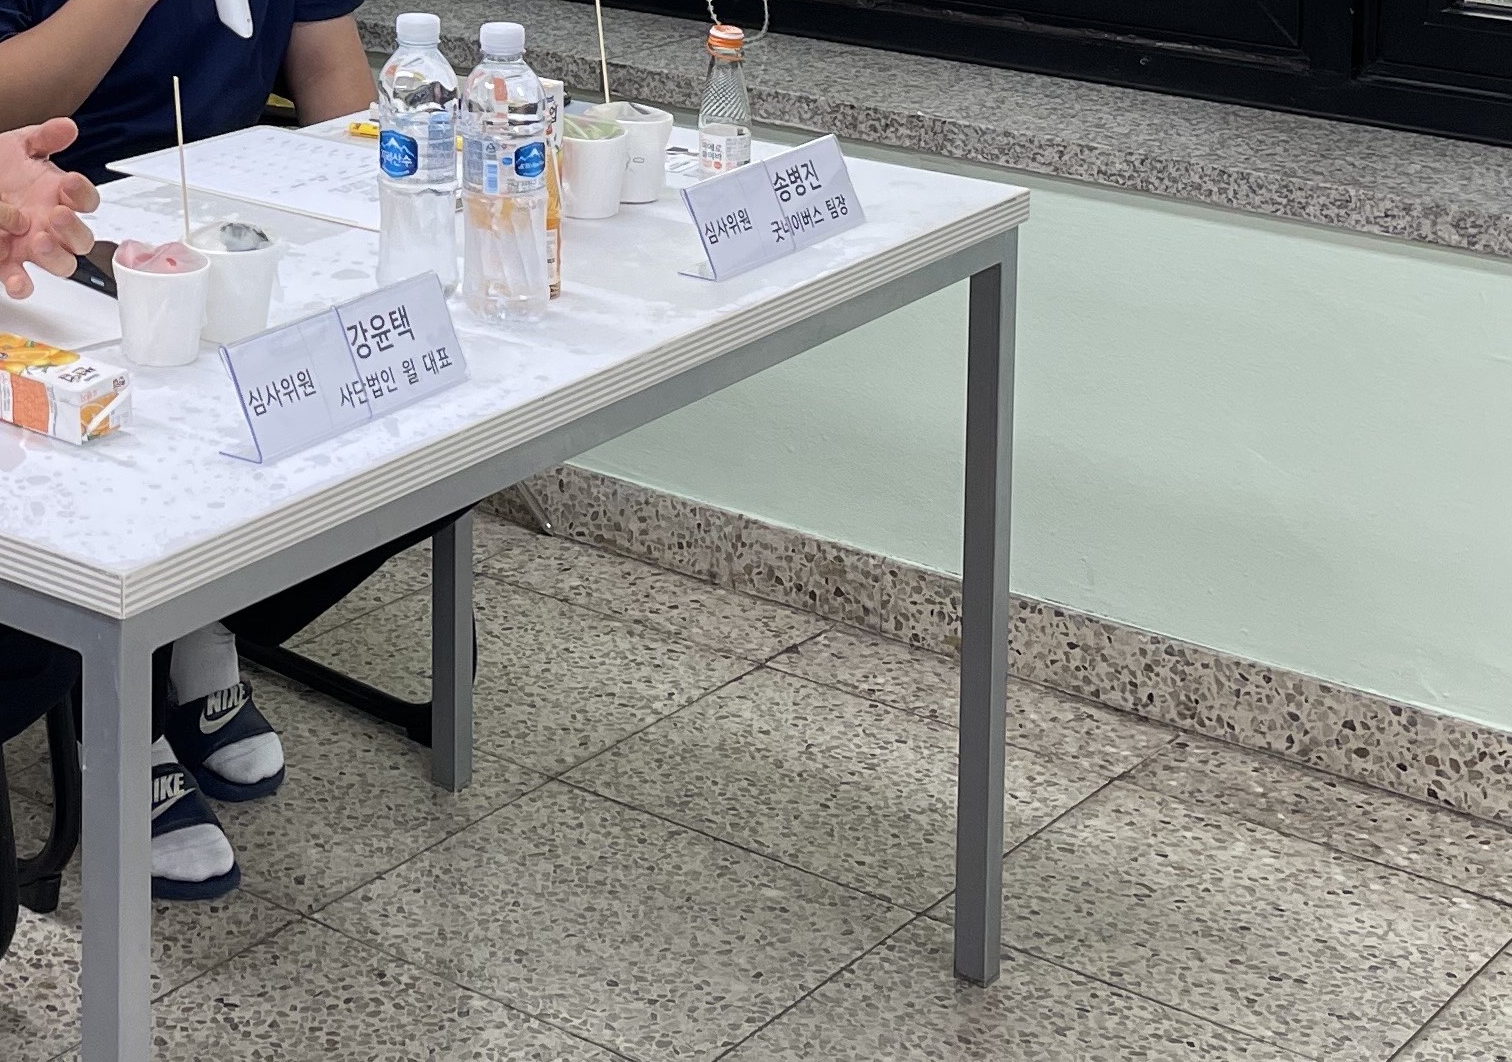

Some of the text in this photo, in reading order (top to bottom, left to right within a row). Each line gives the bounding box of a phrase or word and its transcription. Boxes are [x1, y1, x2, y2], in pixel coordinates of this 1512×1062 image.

[773, 159, 822, 202] 송병진
[704, 194, 849, 245] 심사위원 굿네이버스 팀장
[346, 304, 416, 359] 강윤택
[248, 368, 317, 417] 심사위원
[340, 366, 398, 408] 사단법인
[422, 346, 453, 375] 대표
[206, 682, 246, 716] NIKE
[152, 772, 185, 803] IKE
